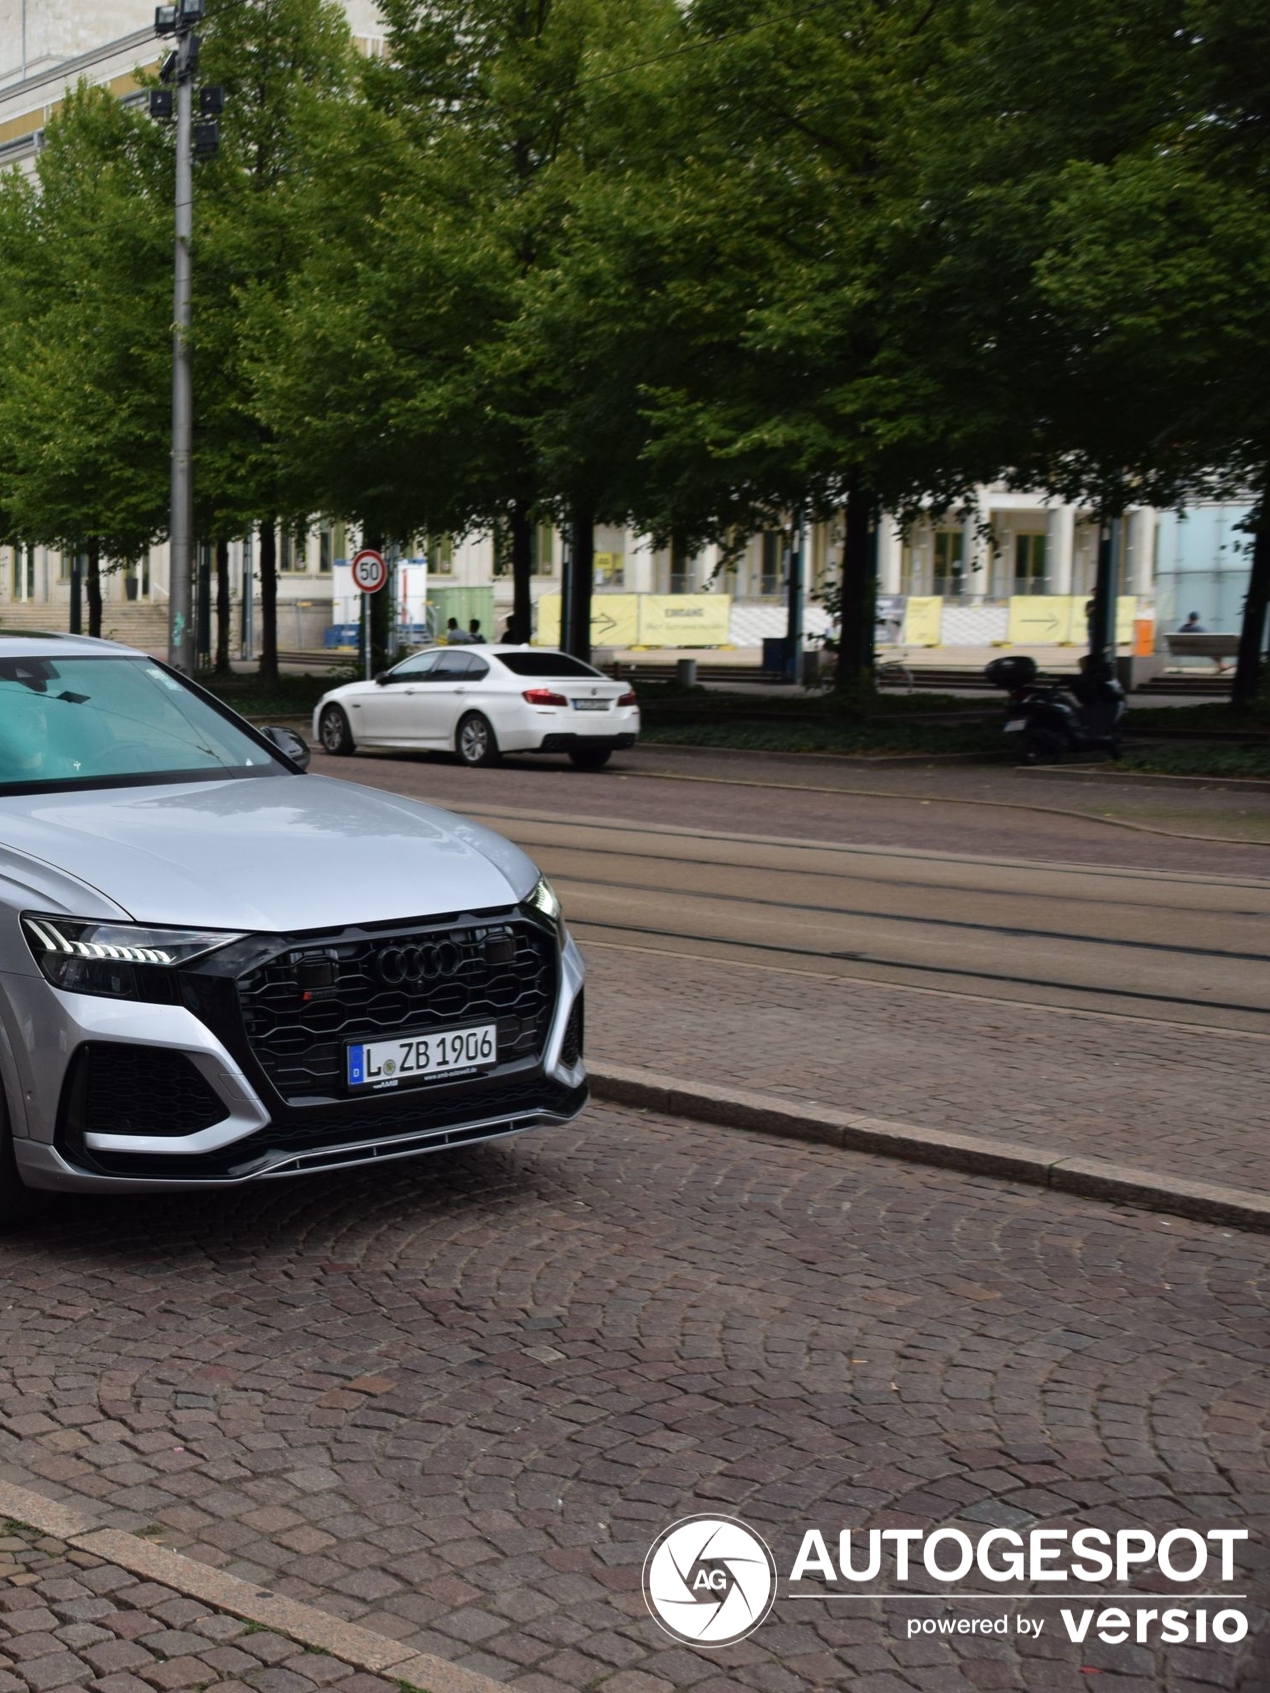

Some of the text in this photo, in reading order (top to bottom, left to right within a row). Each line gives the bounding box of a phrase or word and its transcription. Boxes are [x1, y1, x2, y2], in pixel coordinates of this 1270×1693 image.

[360, 562, 379, 581] 50
[366, 1030, 493, 1077] L ZB 1906
[353, 1068, 360, 1077] D
